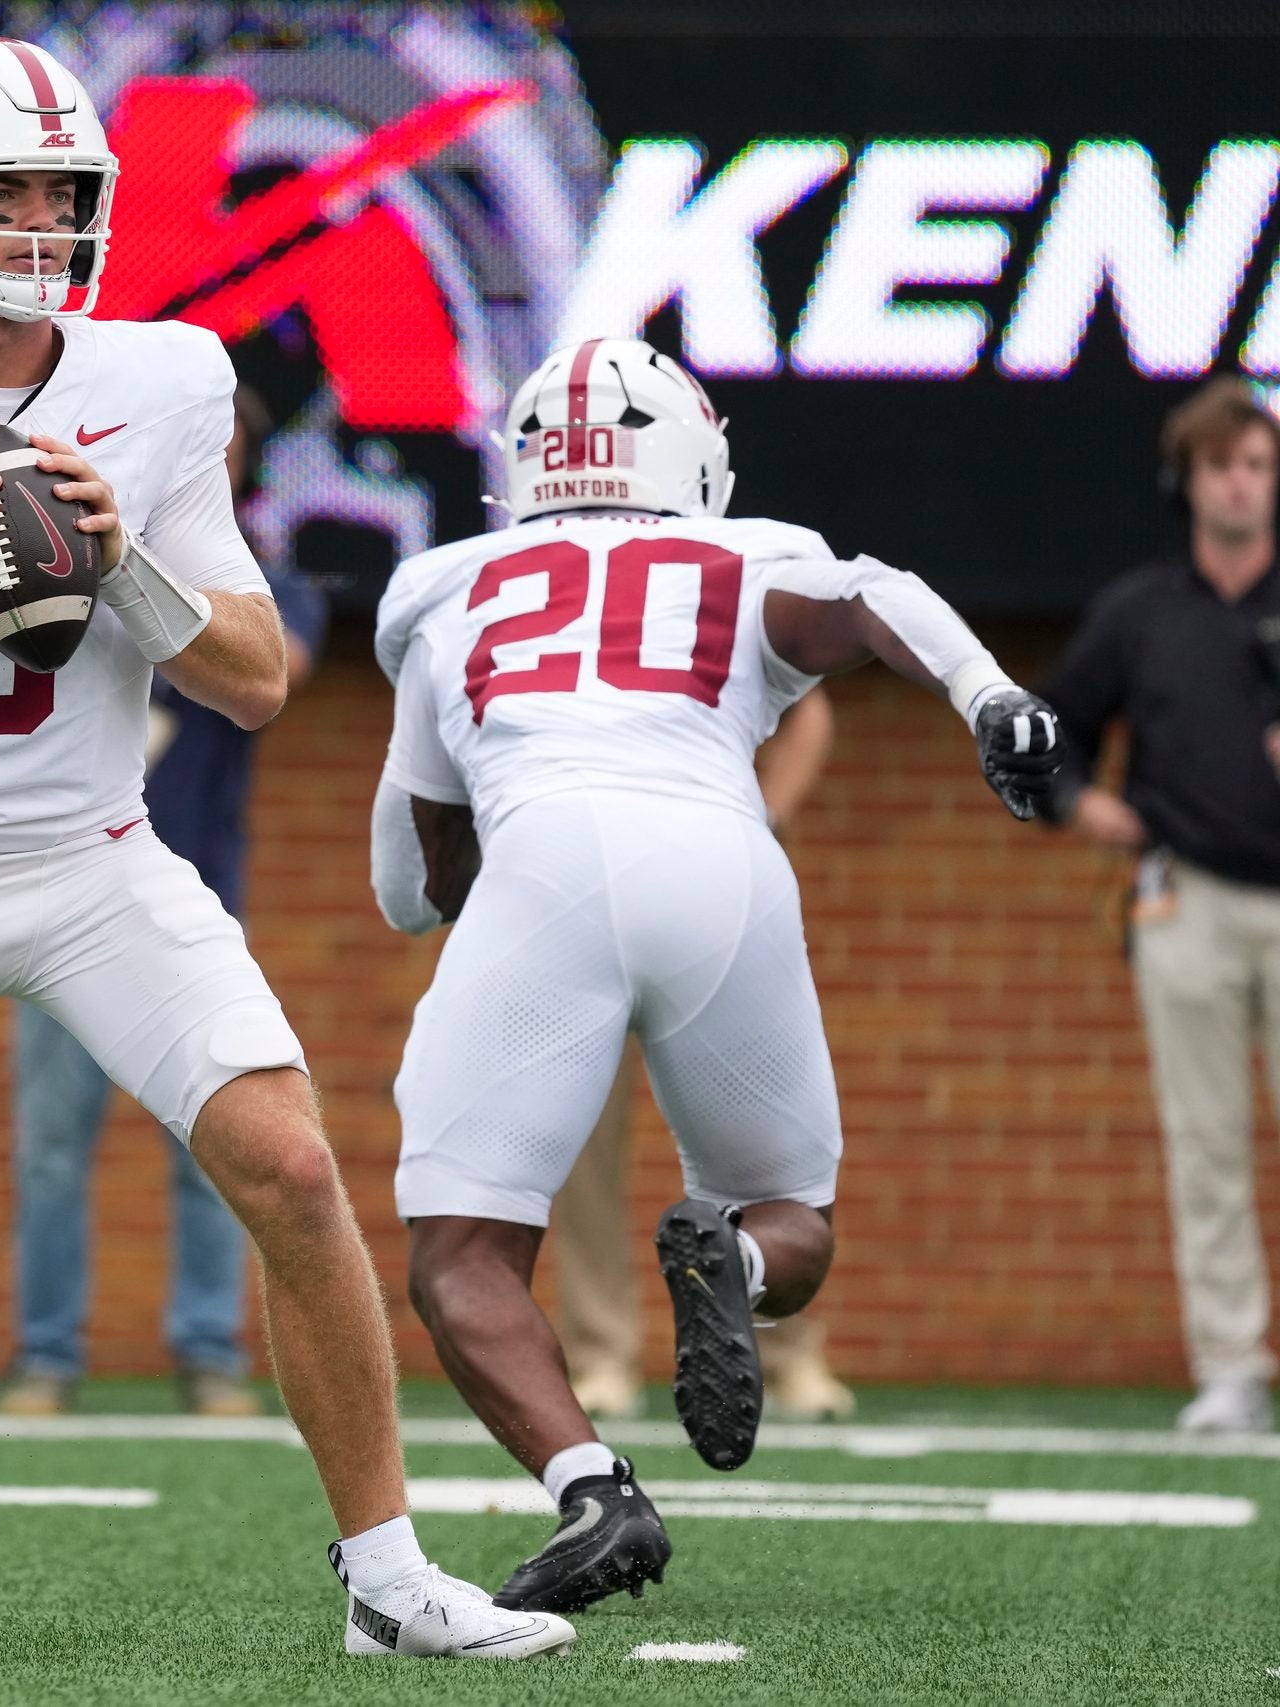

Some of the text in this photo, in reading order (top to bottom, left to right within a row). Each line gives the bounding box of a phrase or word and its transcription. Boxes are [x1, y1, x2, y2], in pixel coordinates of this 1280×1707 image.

[39, 133, 75, 147] ACC
[552, 135, 1280, 380] KEN
[543, 427, 614, 472] 20
[533, 480, 630, 502] STANFORD
[464, 537, 743, 727] 20
[351, 1595, 402, 1650] NIKE
